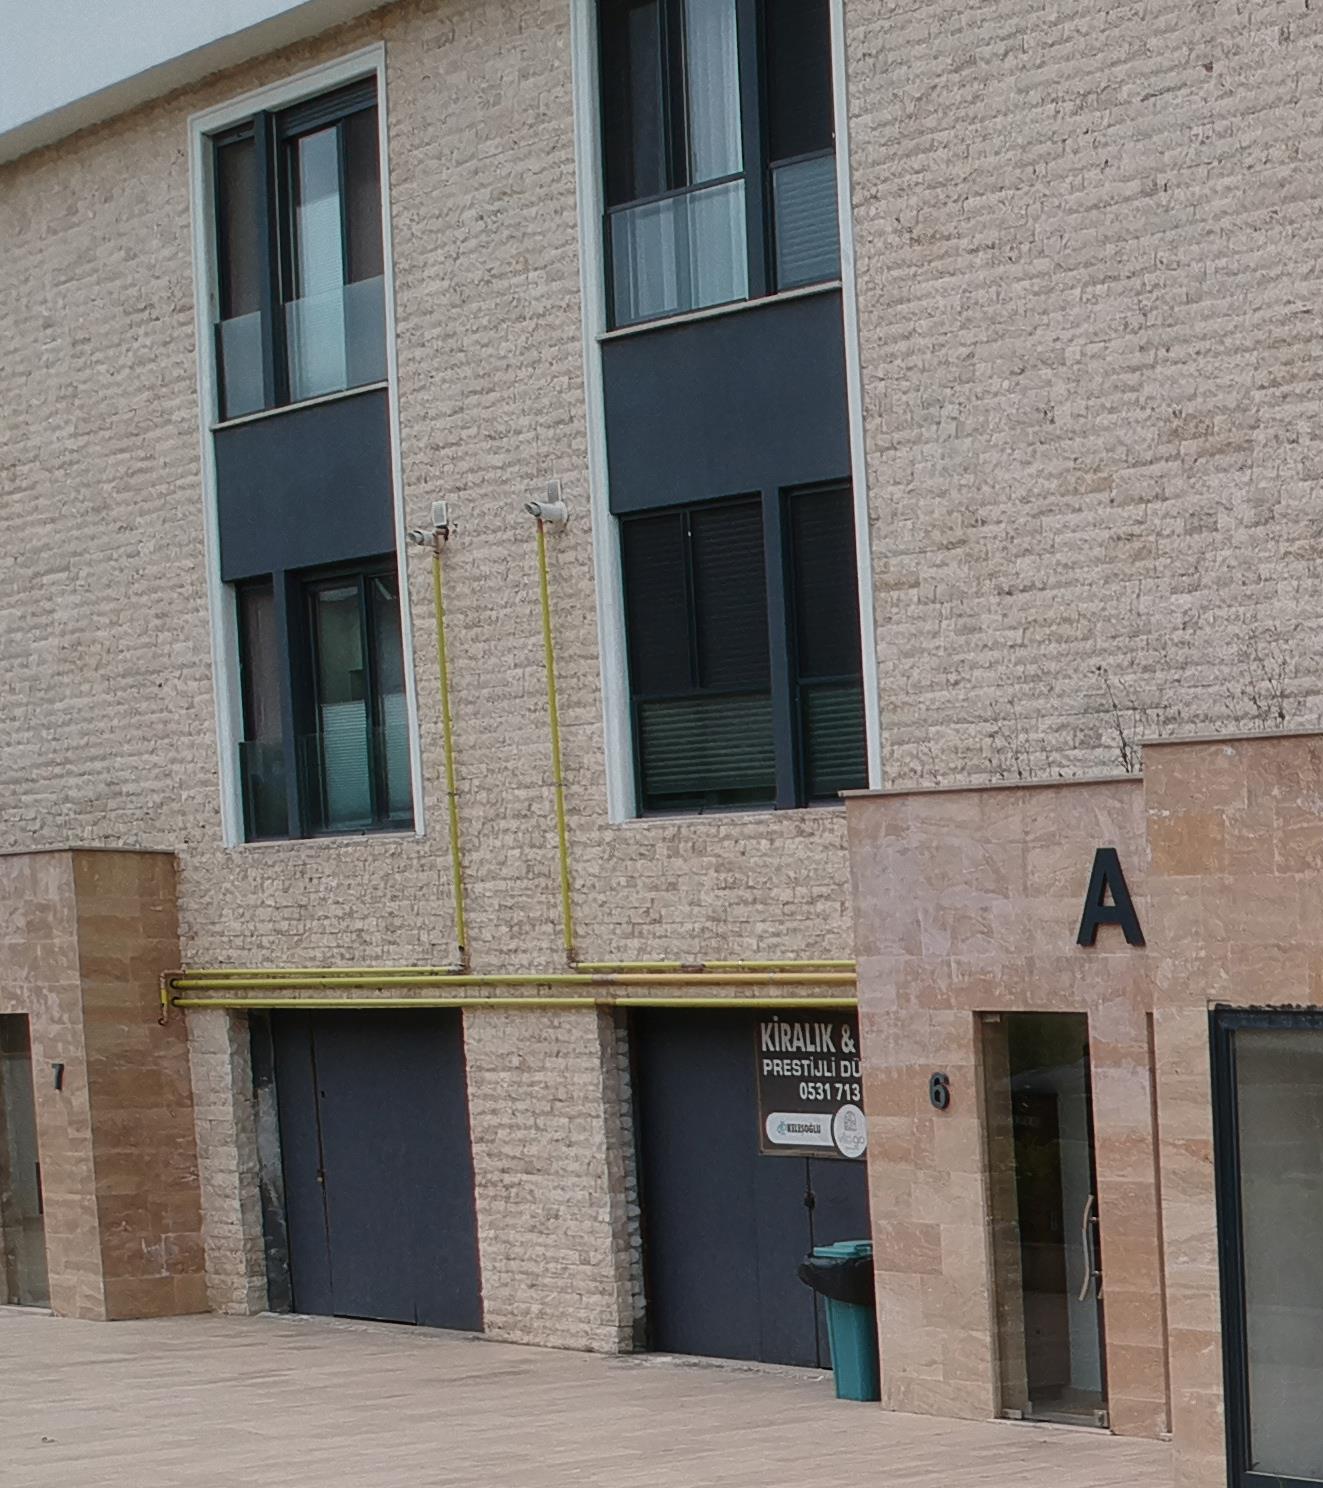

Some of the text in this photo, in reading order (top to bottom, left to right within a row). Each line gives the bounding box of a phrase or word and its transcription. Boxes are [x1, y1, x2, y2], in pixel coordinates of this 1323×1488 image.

[1077, 848, 1146, 946] A
[760, 1016, 856, 1053] KİRALIK &
[51, 1063, 64, 1090] 7
[763, 1056, 836, 1077] PRESTİJLİ
[800, 1082, 861, 1101] 0531 713
[930, 1072, 950, 1110] 6
